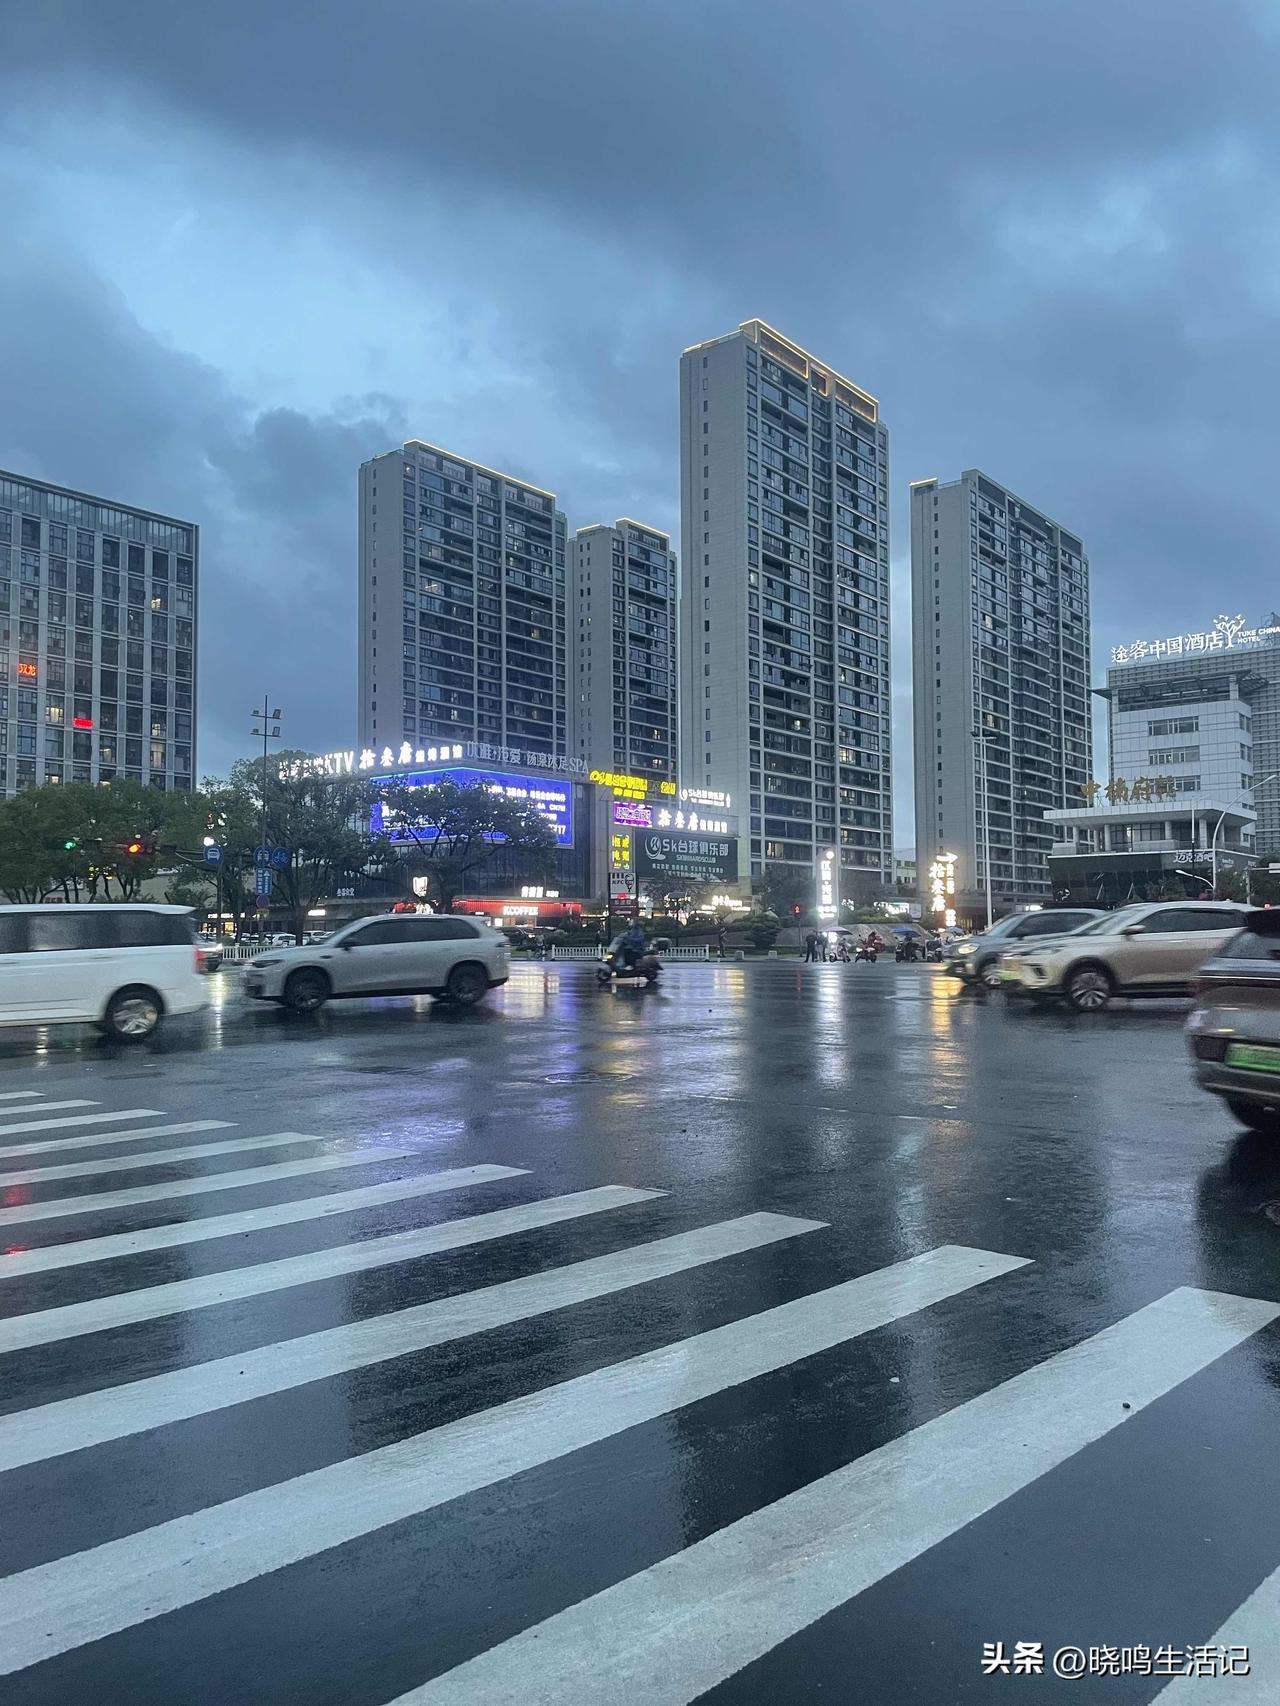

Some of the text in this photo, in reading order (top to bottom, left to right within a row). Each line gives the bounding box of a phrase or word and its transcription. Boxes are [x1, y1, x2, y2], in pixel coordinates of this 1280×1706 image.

[1237, 630, 1257, 639] TUKE
[1237, 636, 1261, 644] HOTEL
[1111, 631, 1224, 663] 途客中国酒店
[662, 839, 729, 857] Sk台球俱乐部
[503, 905, 539, 916] KCOFFEE
